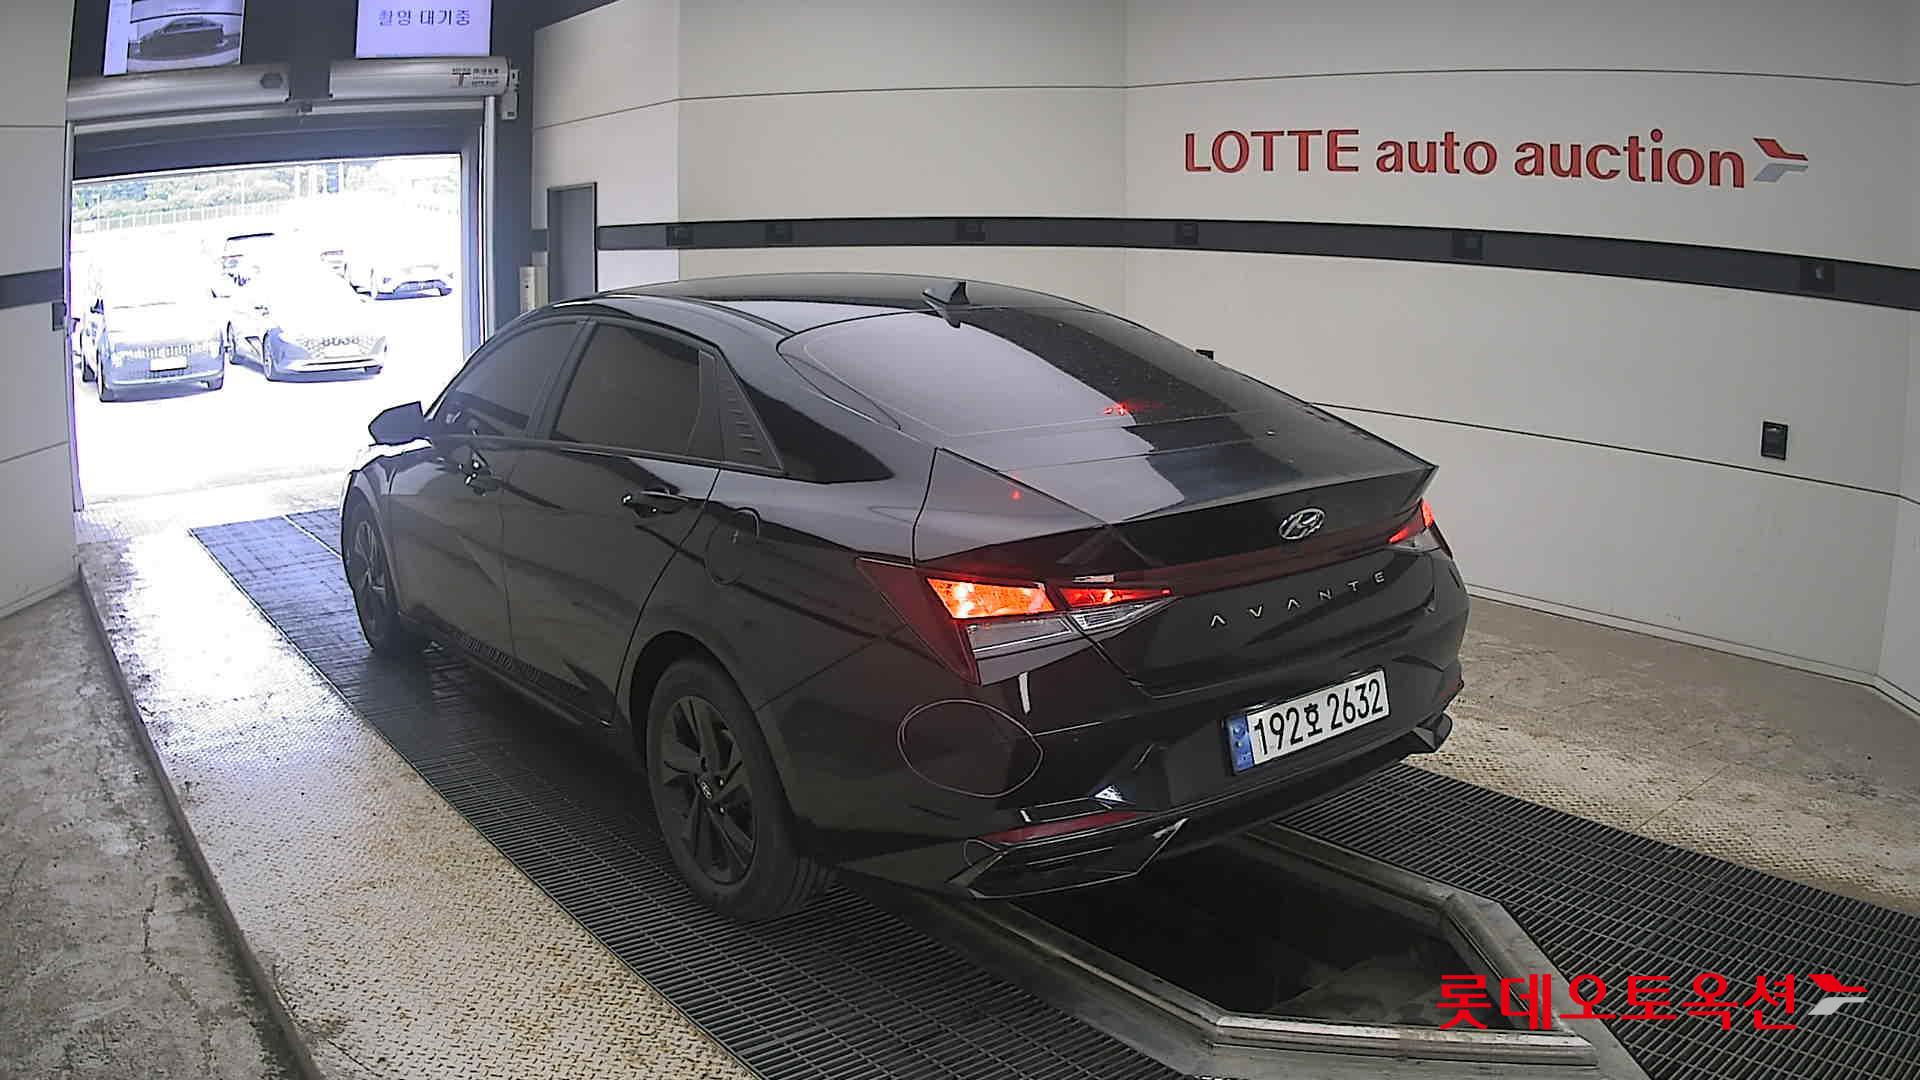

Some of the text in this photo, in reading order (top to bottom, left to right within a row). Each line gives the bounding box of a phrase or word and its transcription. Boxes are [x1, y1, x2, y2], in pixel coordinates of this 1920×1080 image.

[420, 9, 470, 26] 대기중
[1185, 128, 1745, 188] LOTTE auto auction
[1210, 571, 1385, 627] AVANTE
[1254, 678, 1384, 755] 192호 2632
